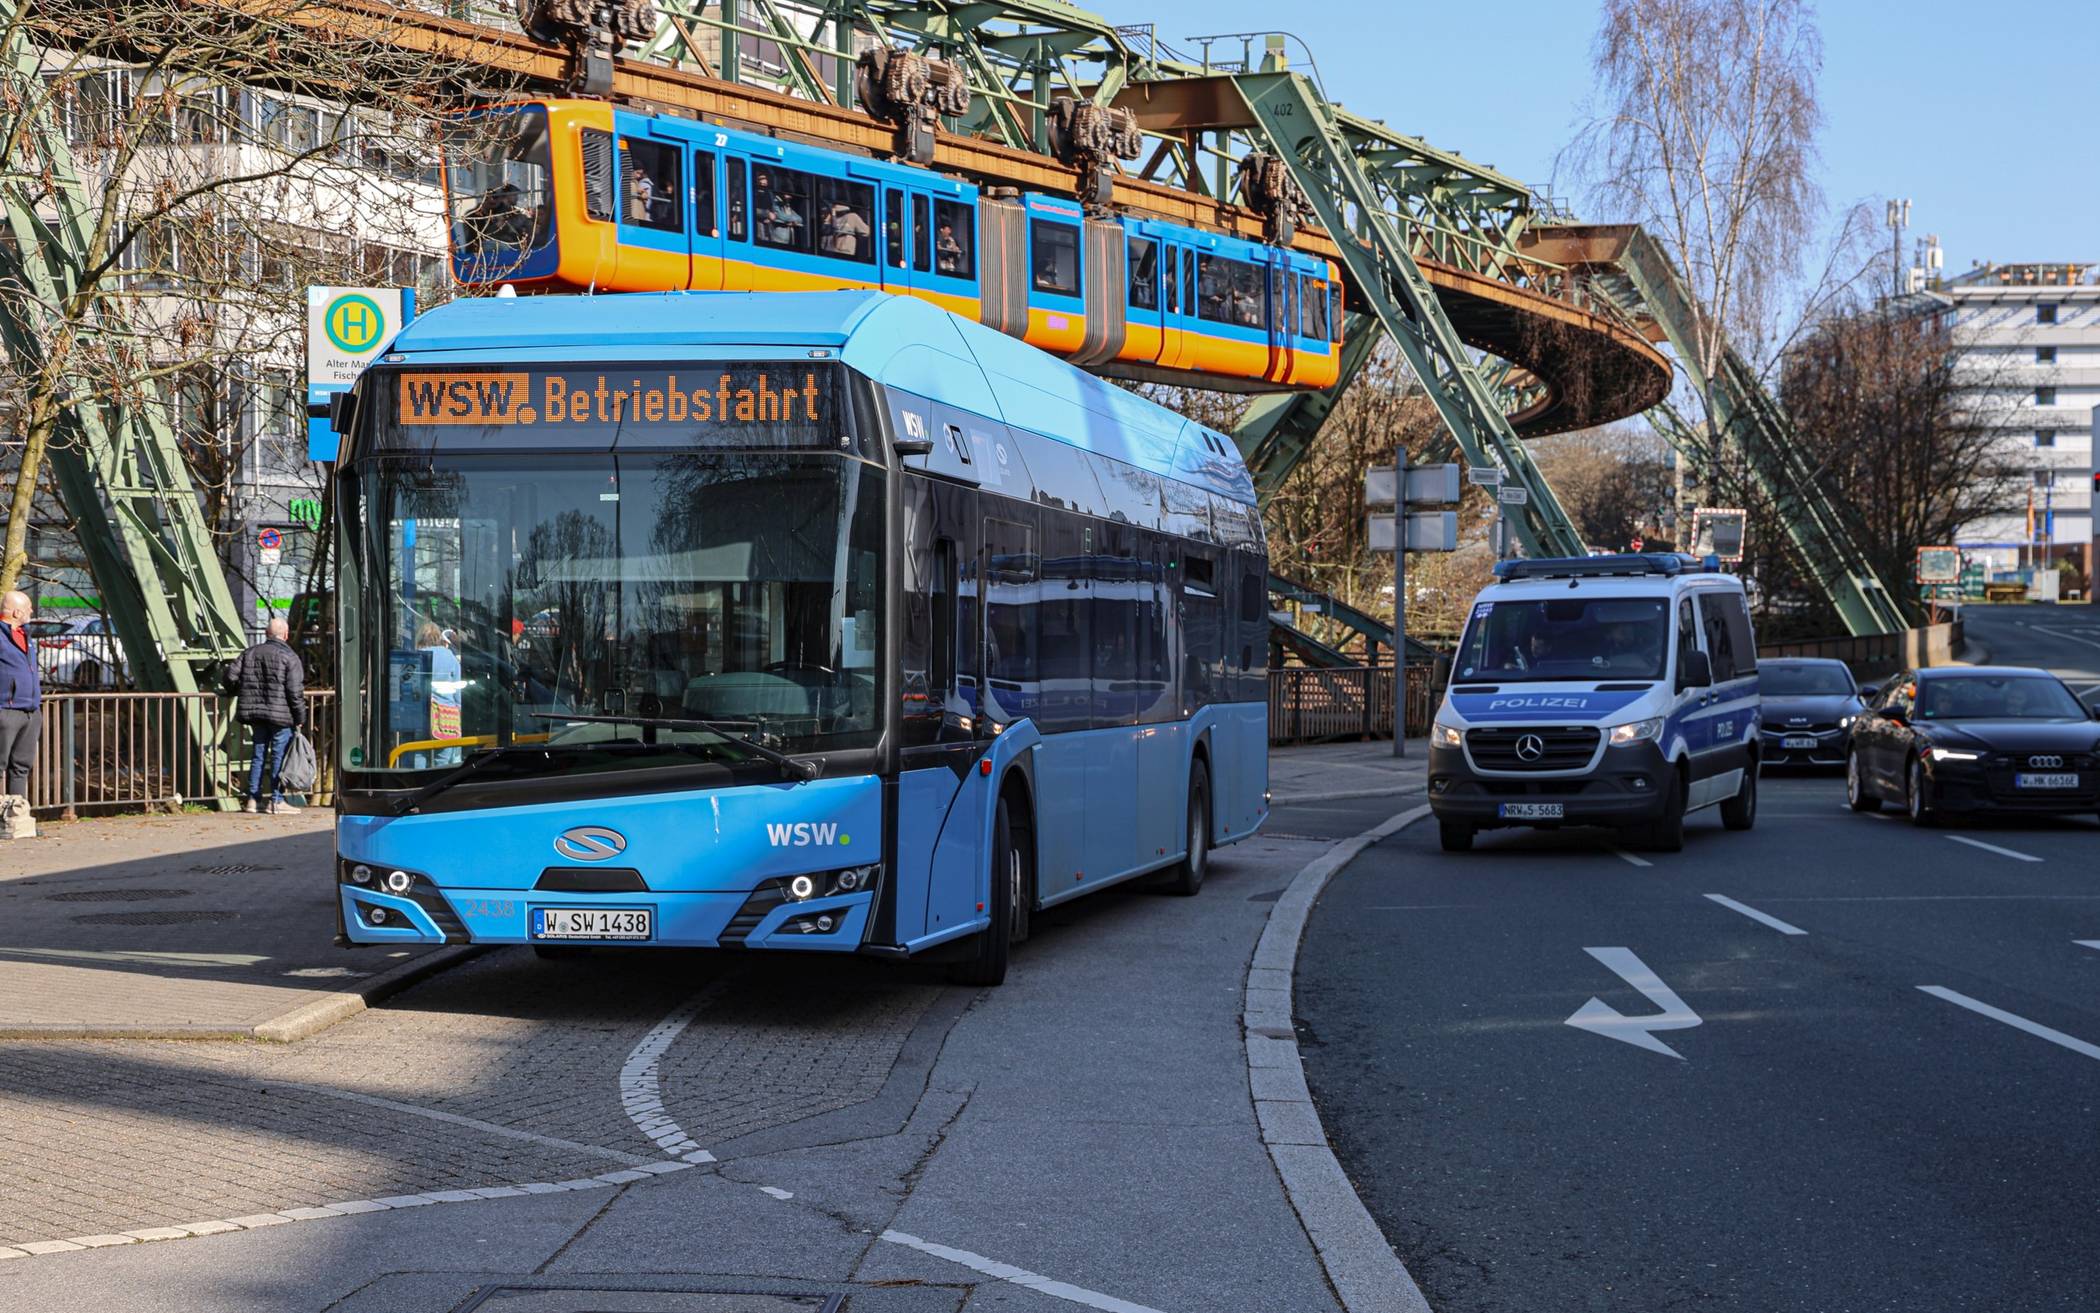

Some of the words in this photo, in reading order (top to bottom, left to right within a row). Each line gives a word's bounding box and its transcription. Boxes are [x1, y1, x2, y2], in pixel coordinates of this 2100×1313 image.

[1273, 102, 1293, 116] 402
[326, 360, 348, 368] Alter
[545, 374, 819, 422] Betriebsfahrt
[1489, 698, 1587, 710] POLIZEI
[1504, 804, 1522, 816] NRW
[1538, 804, 1562, 816] 5683
[465, 899, 514, 919] 2438
[546, 912, 557, 931] W
[570, 913, 594, 932] SW
[600, 913, 647, 932] 1438
